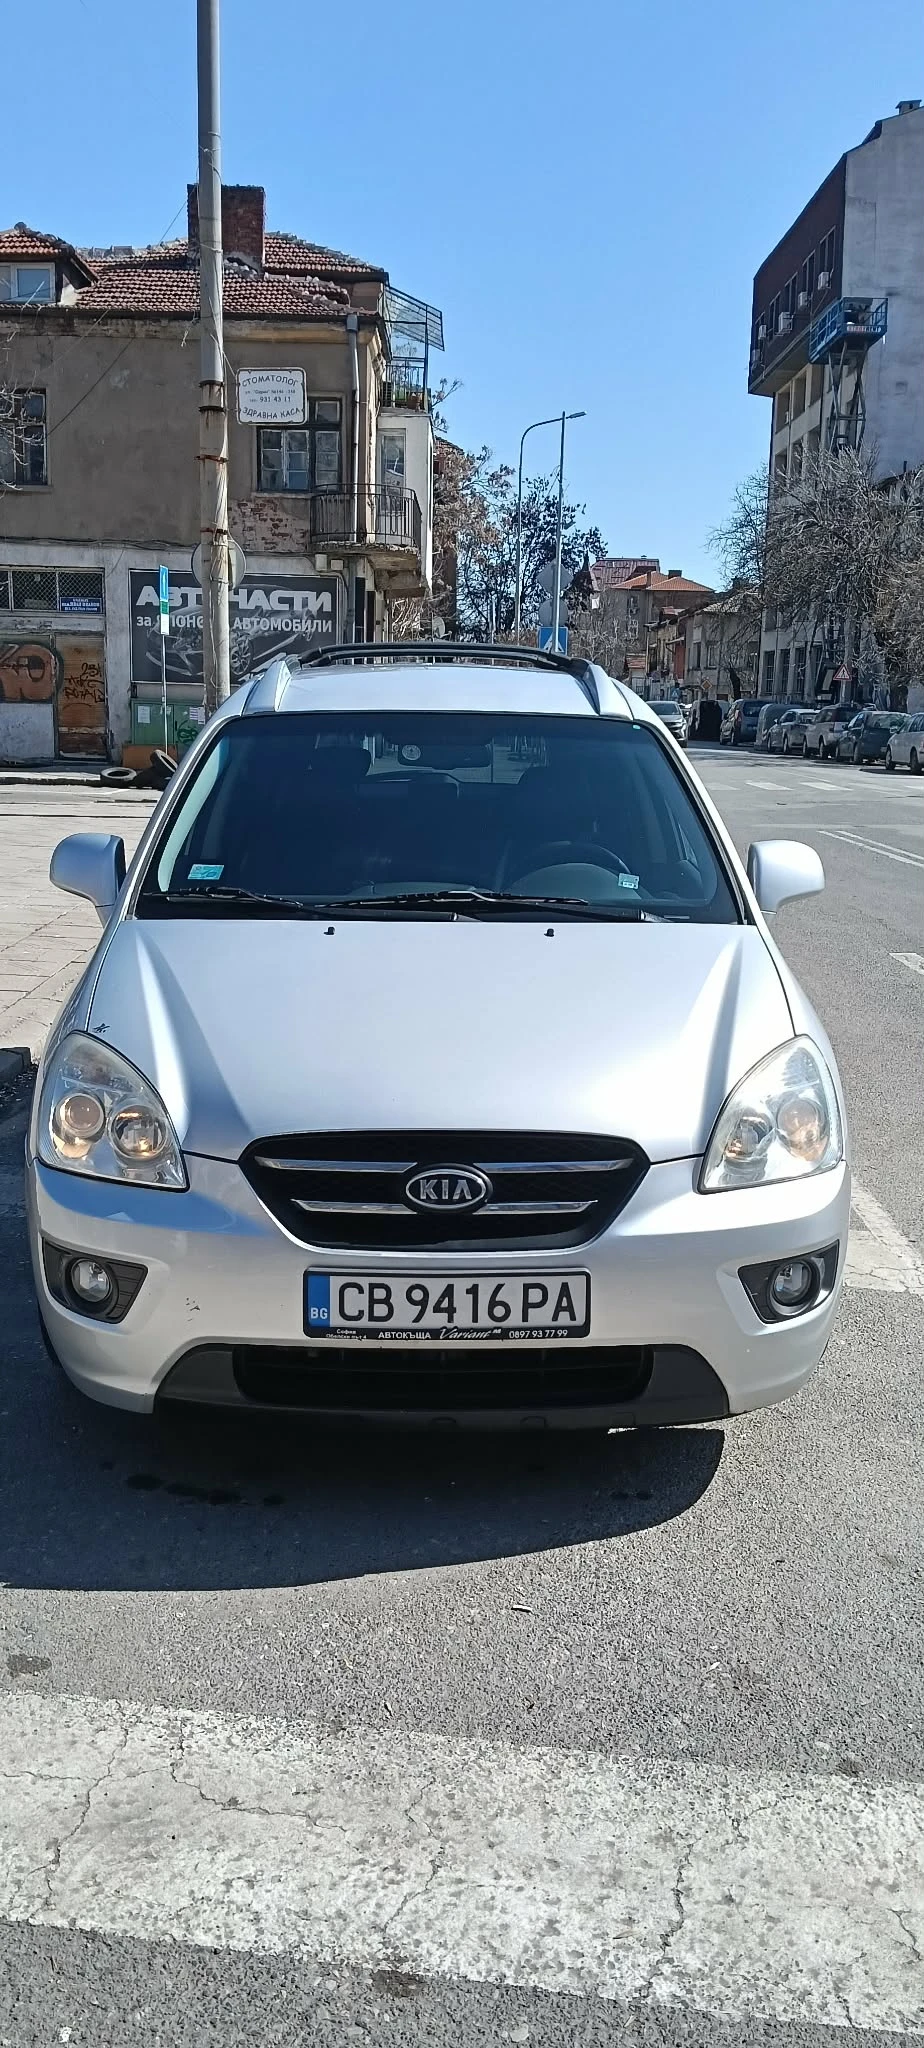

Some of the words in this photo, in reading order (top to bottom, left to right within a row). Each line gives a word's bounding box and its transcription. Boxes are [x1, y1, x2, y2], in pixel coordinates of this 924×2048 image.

[242, 374, 299, 387] СТОМАТОЛОГ
[242, 406, 278, 420] ЗДРАВНА
[280, 406, 301, 419] КАСА
[232, 616, 332, 633] АВТОМОБИЛИ
[419, 1179, 472, 1200] KIA
[309, 1307, 329, 1321] BG
[337, 1281, 395, 1324] CB
[404, 1282, 512, 1324] 9416
[521, 1281, 577, 1323] PA
[377, 1331, 432, 1340] АВТОКЪЩА
[439, 1328, 491, 1340] Variant
[508, 1330, 531, 1339] 0897
[531, 1329, 543, 1339] 93
[544, 1329, 555, 1338] 77
[556, 1328, 568, 1338] 99
